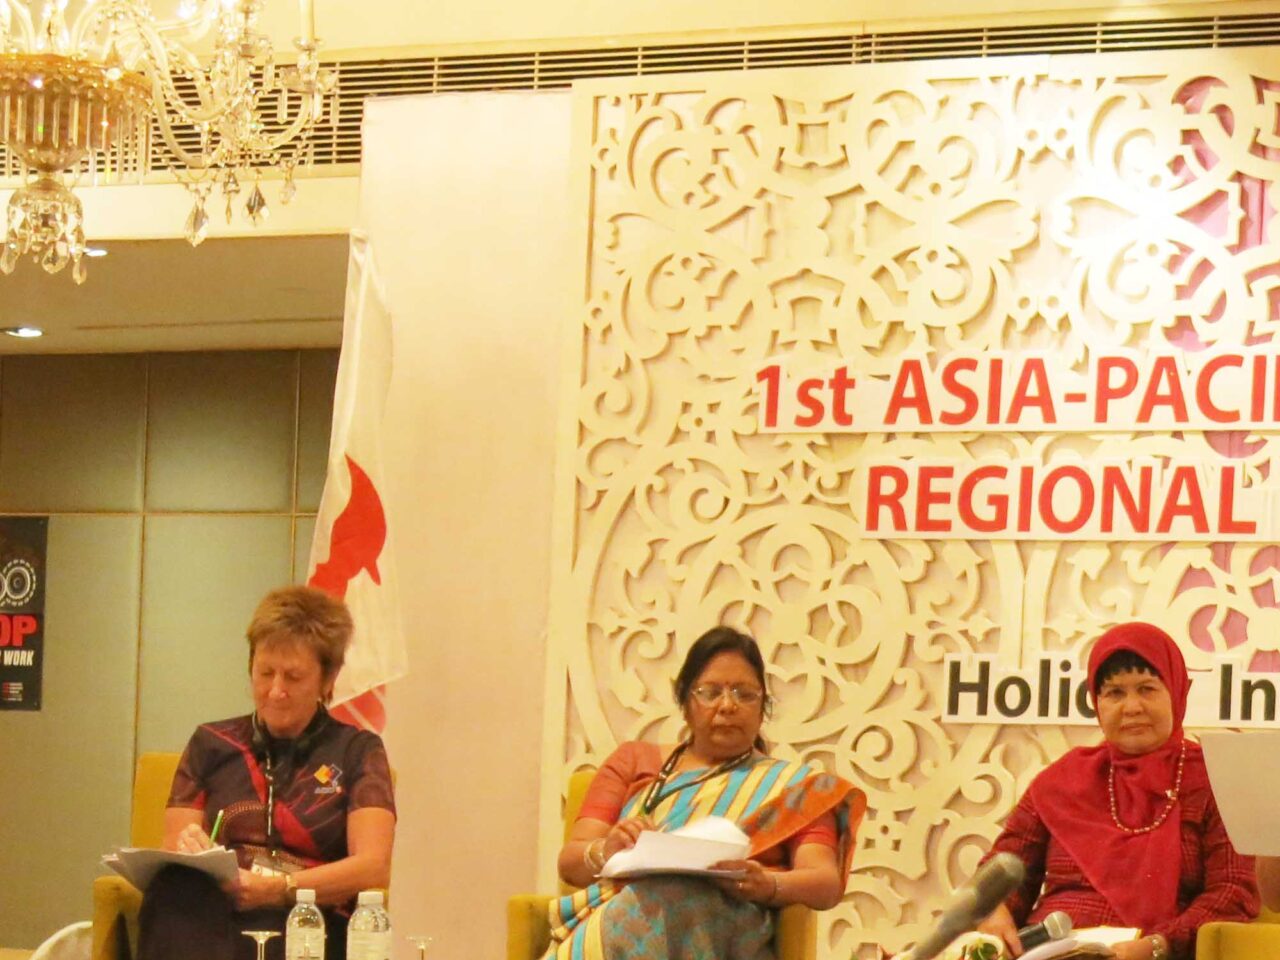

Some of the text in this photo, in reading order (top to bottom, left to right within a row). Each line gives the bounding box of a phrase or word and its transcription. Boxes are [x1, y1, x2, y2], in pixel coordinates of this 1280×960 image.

[756, 363, 856, 429] 1st
[865, 463, 1258, 535] REGIONAL
[3, 650, 34, 666] WORK
[946, 658, 1193, 719] Holi
